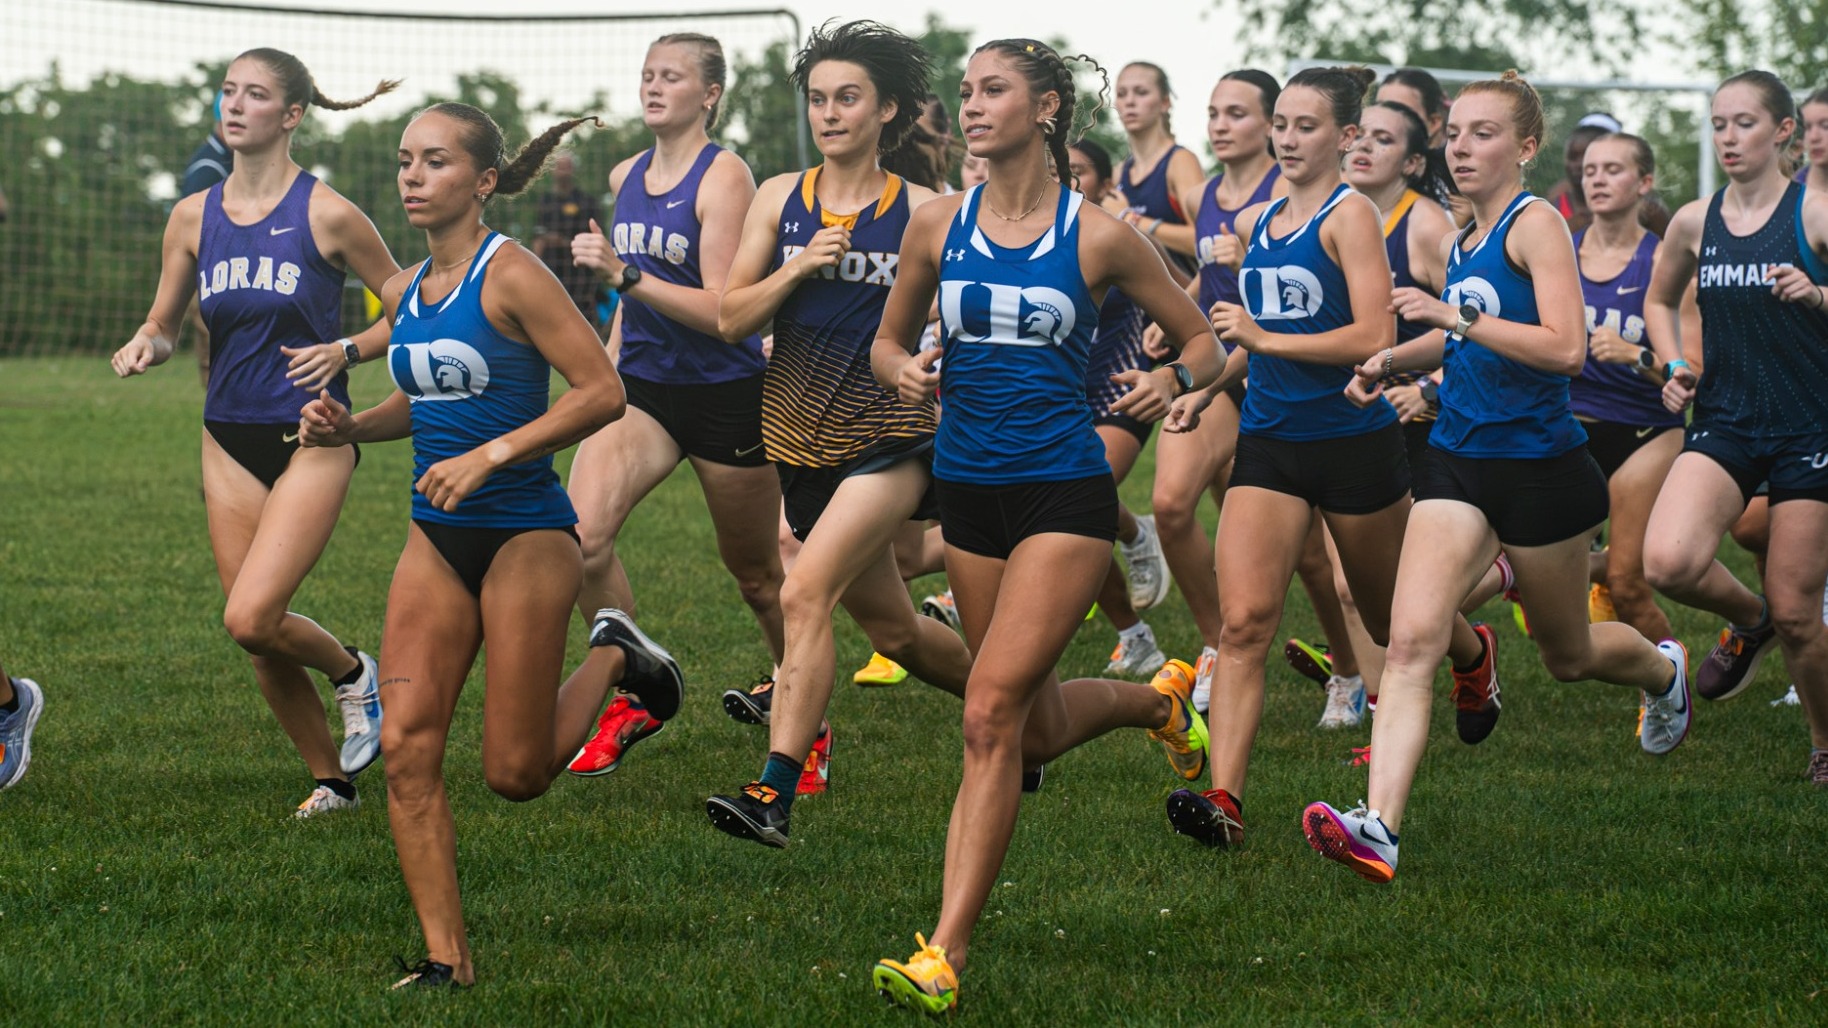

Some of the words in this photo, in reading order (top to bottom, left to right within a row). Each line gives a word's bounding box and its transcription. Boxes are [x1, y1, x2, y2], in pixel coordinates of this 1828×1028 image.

[613, 222, 690, 266] ORAS
[200, 256, 302, 301] LORAS
[1700, 262, 1795, 289] EMMAU
